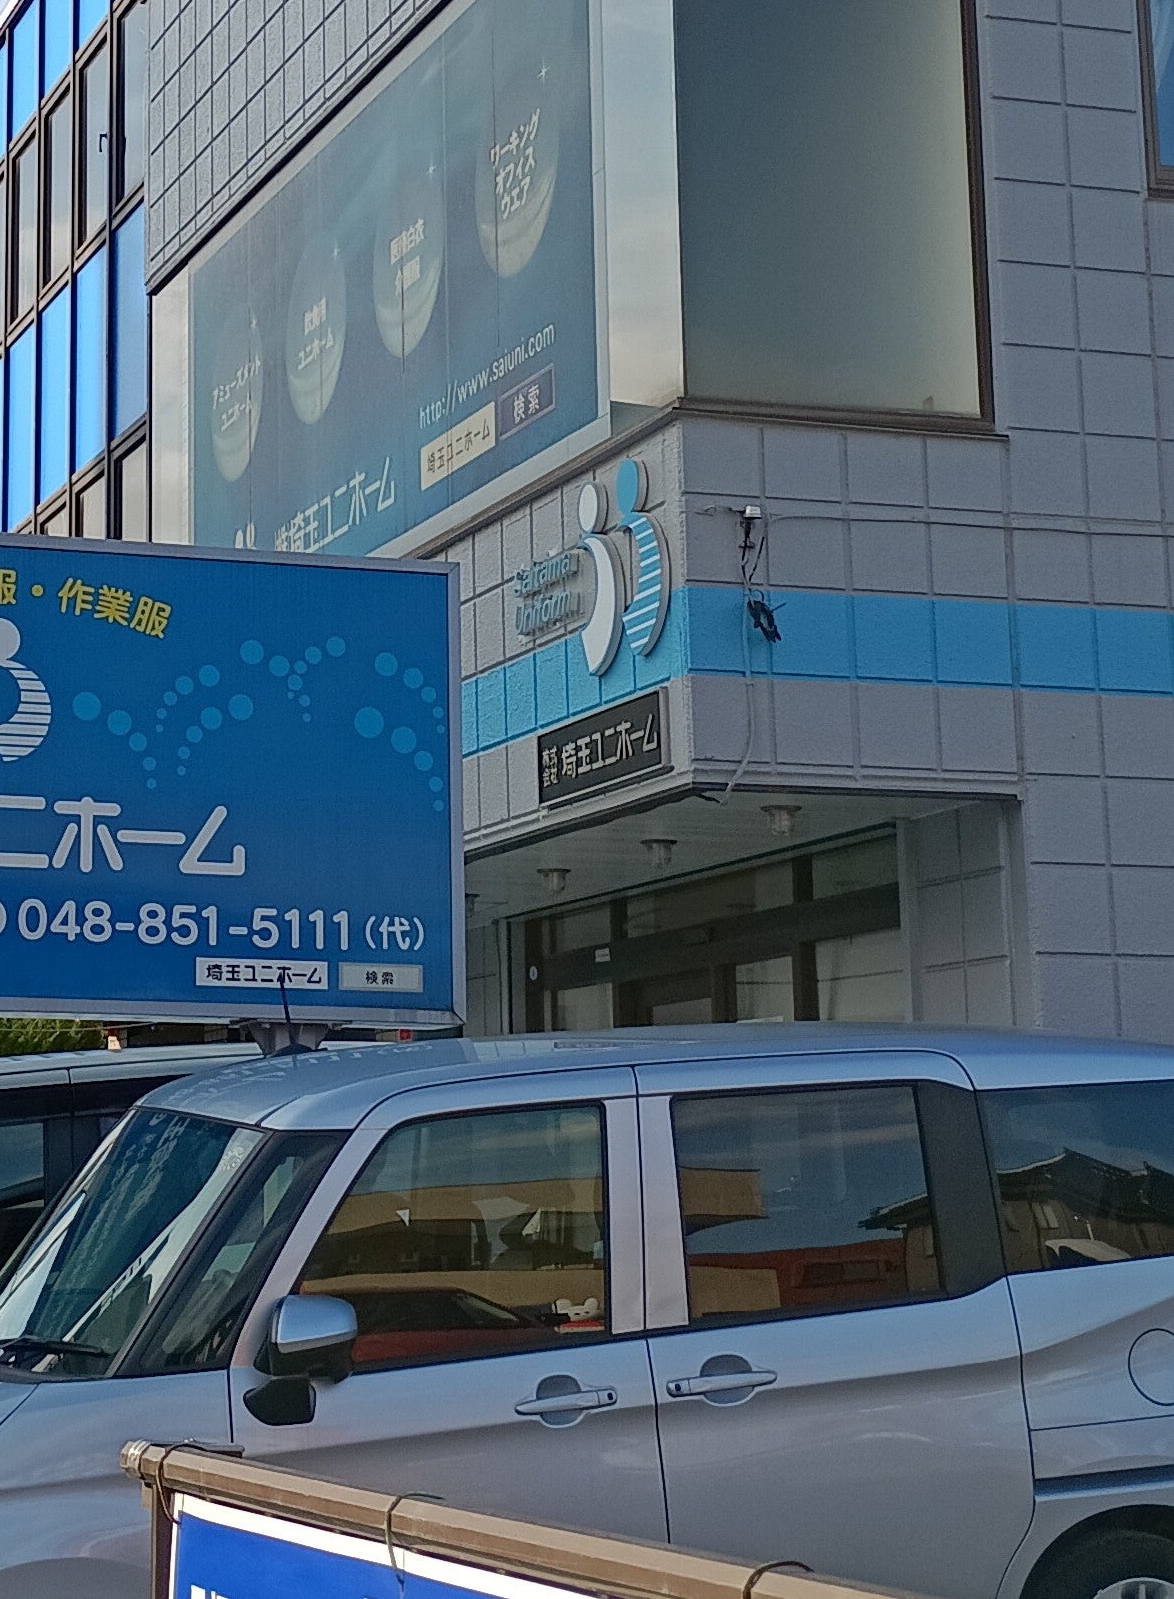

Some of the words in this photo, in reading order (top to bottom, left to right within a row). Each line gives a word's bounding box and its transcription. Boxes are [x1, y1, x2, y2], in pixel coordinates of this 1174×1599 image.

[490, 108, 541, 169] ワーキング
[418, 323, 556, 430] http://www.saiuni.com
[513, 383, 541, 425] 検索
[515, 591, 571, 635] Uniform
[561, 712, 659, 780] 埼玉ユニホーム
[17, 898, 351, 952] 048-851-5111
[364, 915, 426, 952] (代)
[205, 963, 324, 986] 埼玉ユニホーム
[364, 969, 396, 987] 検索
